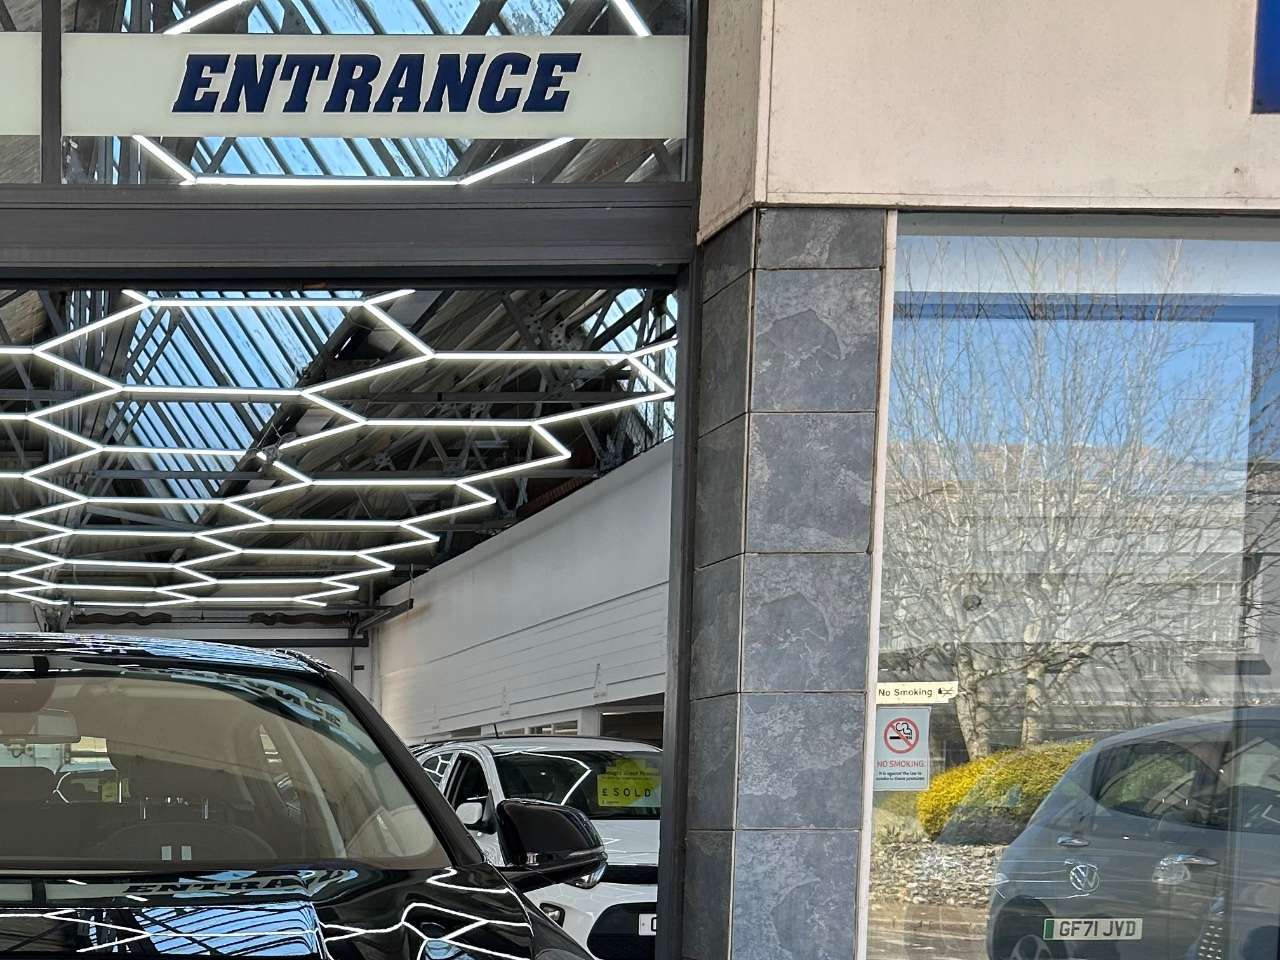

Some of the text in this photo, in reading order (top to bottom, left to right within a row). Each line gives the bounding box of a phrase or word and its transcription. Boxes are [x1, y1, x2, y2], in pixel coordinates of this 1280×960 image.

[172, 52, 582, 114] ENTRANCE
[878, 688, 933, 698] No Smoking
[889, 760, 925, 768] SMOKING
[613, 787, 651, 797] SOLD
[1059, 921, 1136, 937] GF71 JVD
